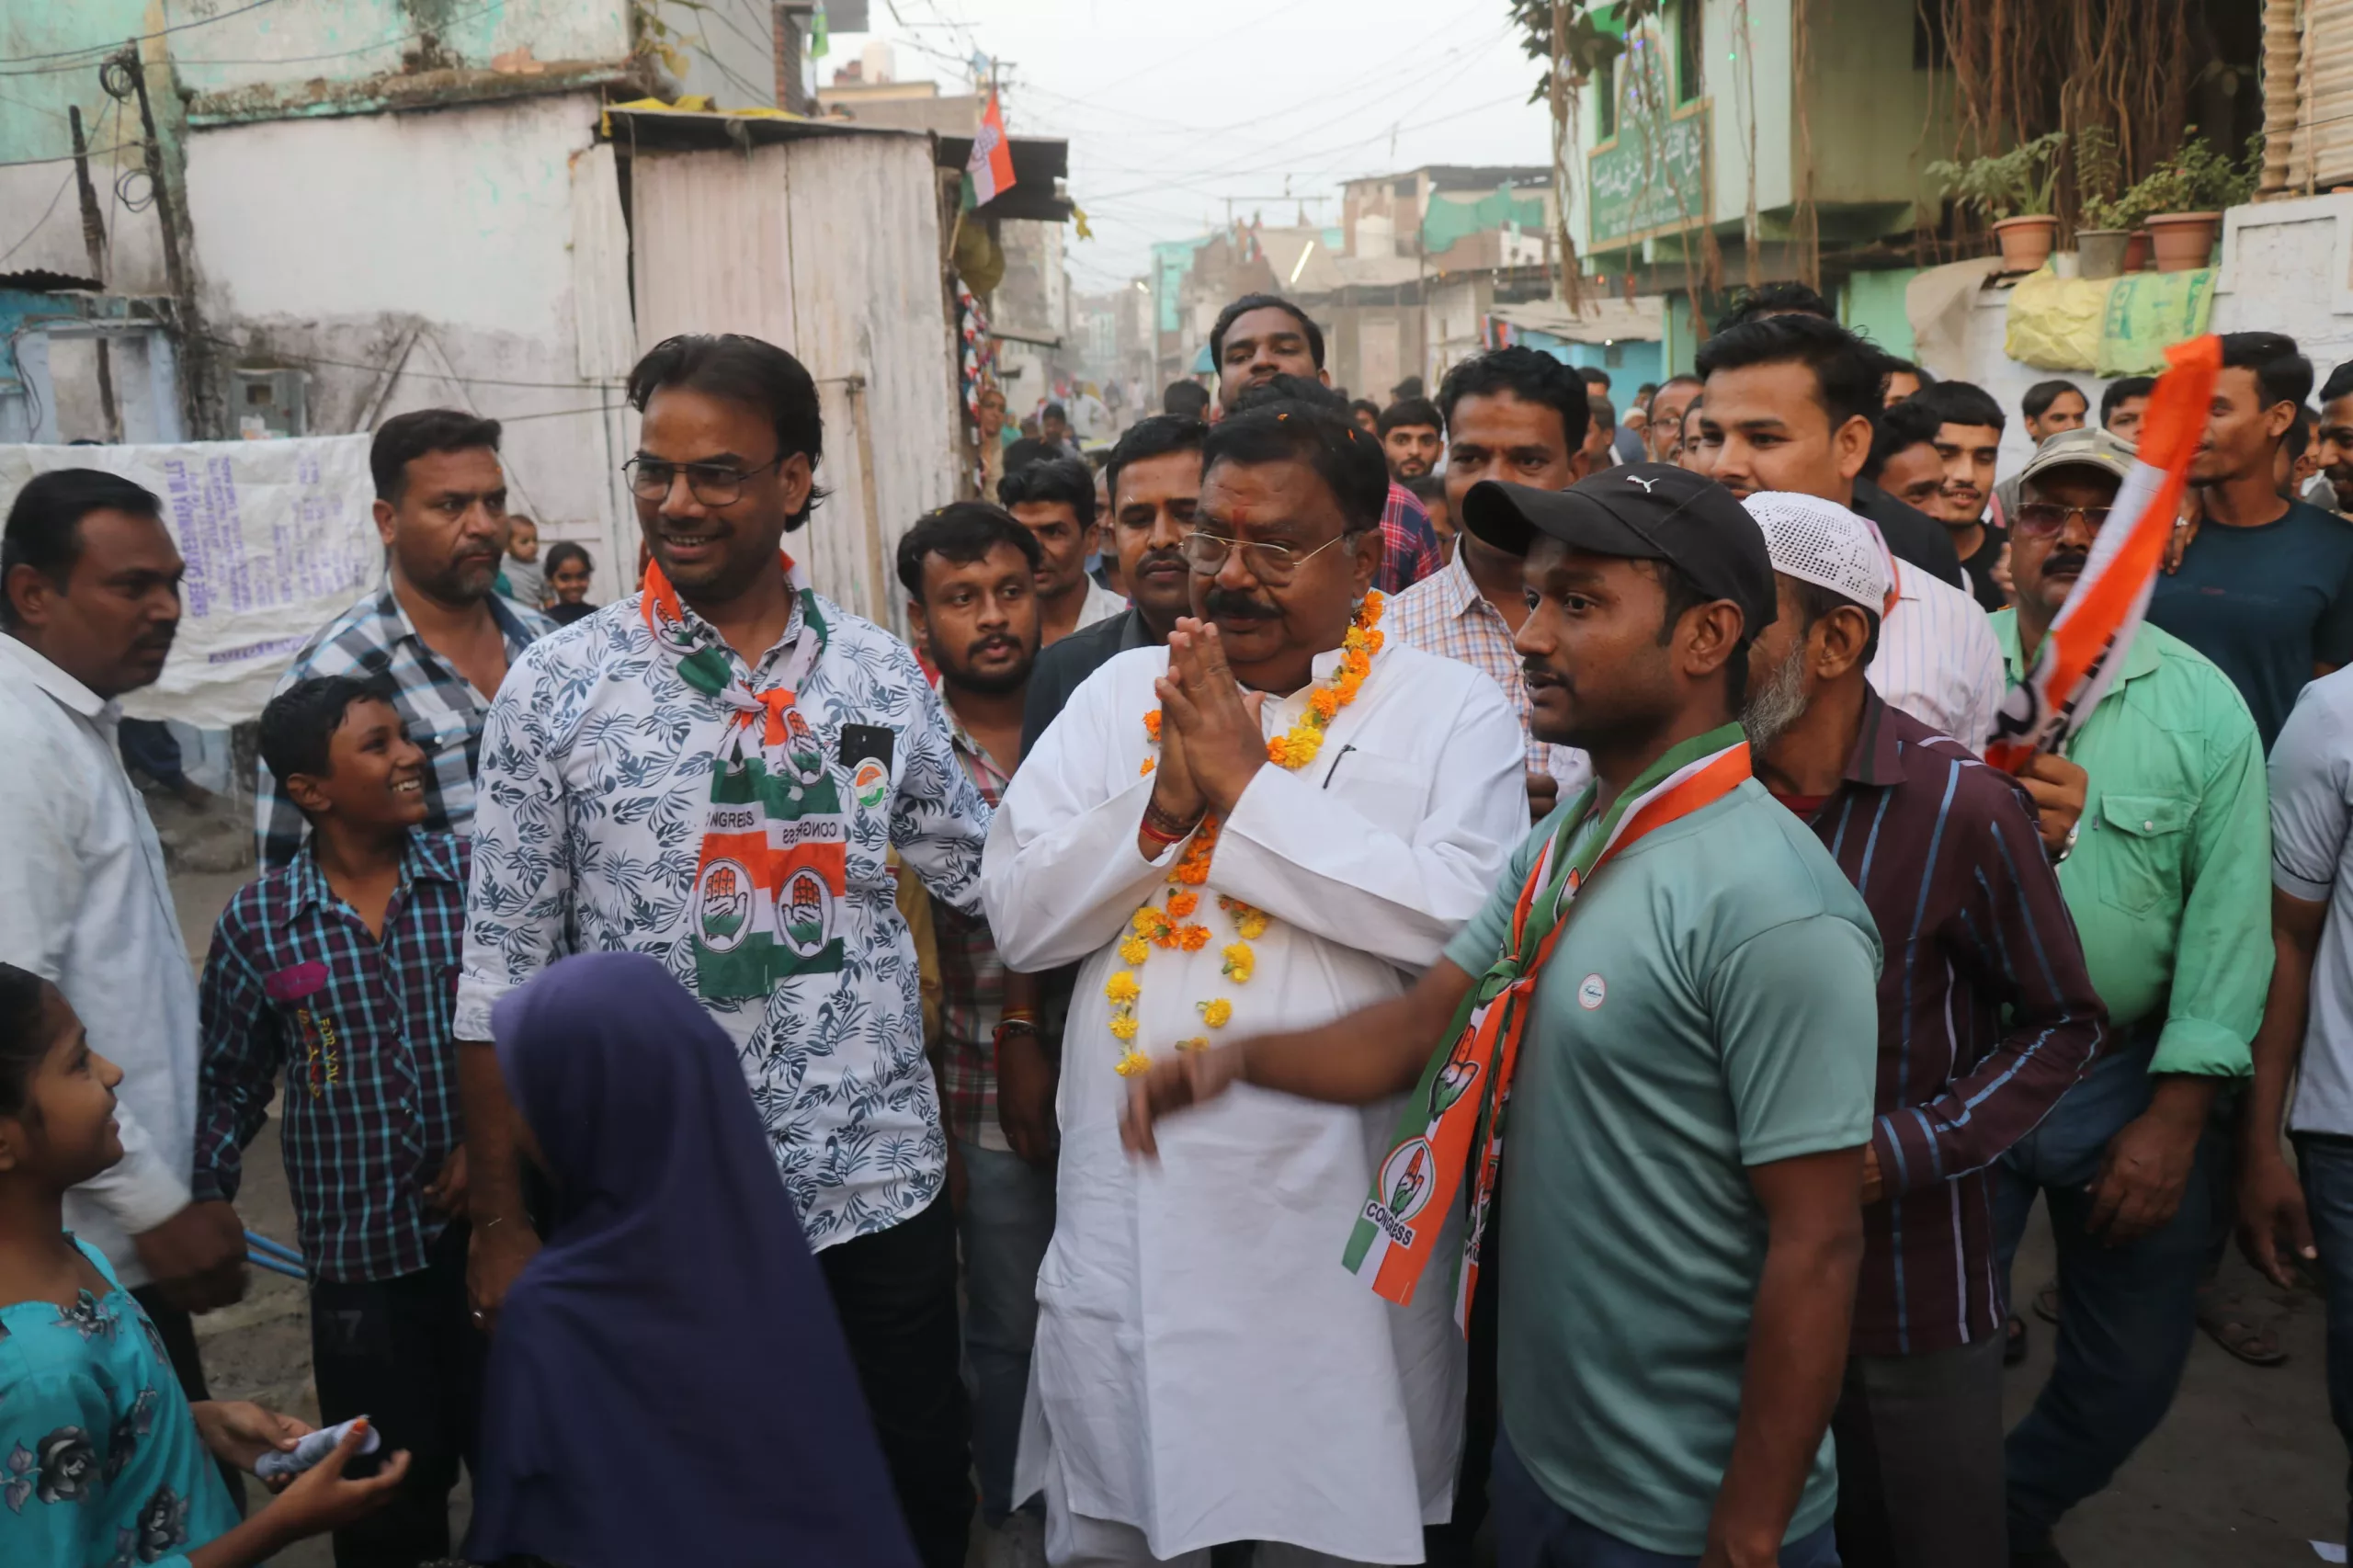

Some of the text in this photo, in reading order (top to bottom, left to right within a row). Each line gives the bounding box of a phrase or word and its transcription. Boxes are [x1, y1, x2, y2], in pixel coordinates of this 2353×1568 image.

[319, 1017, 338, 1084] FOR YOU
[1366, 1202, 1414, 1245] CONGRESS
